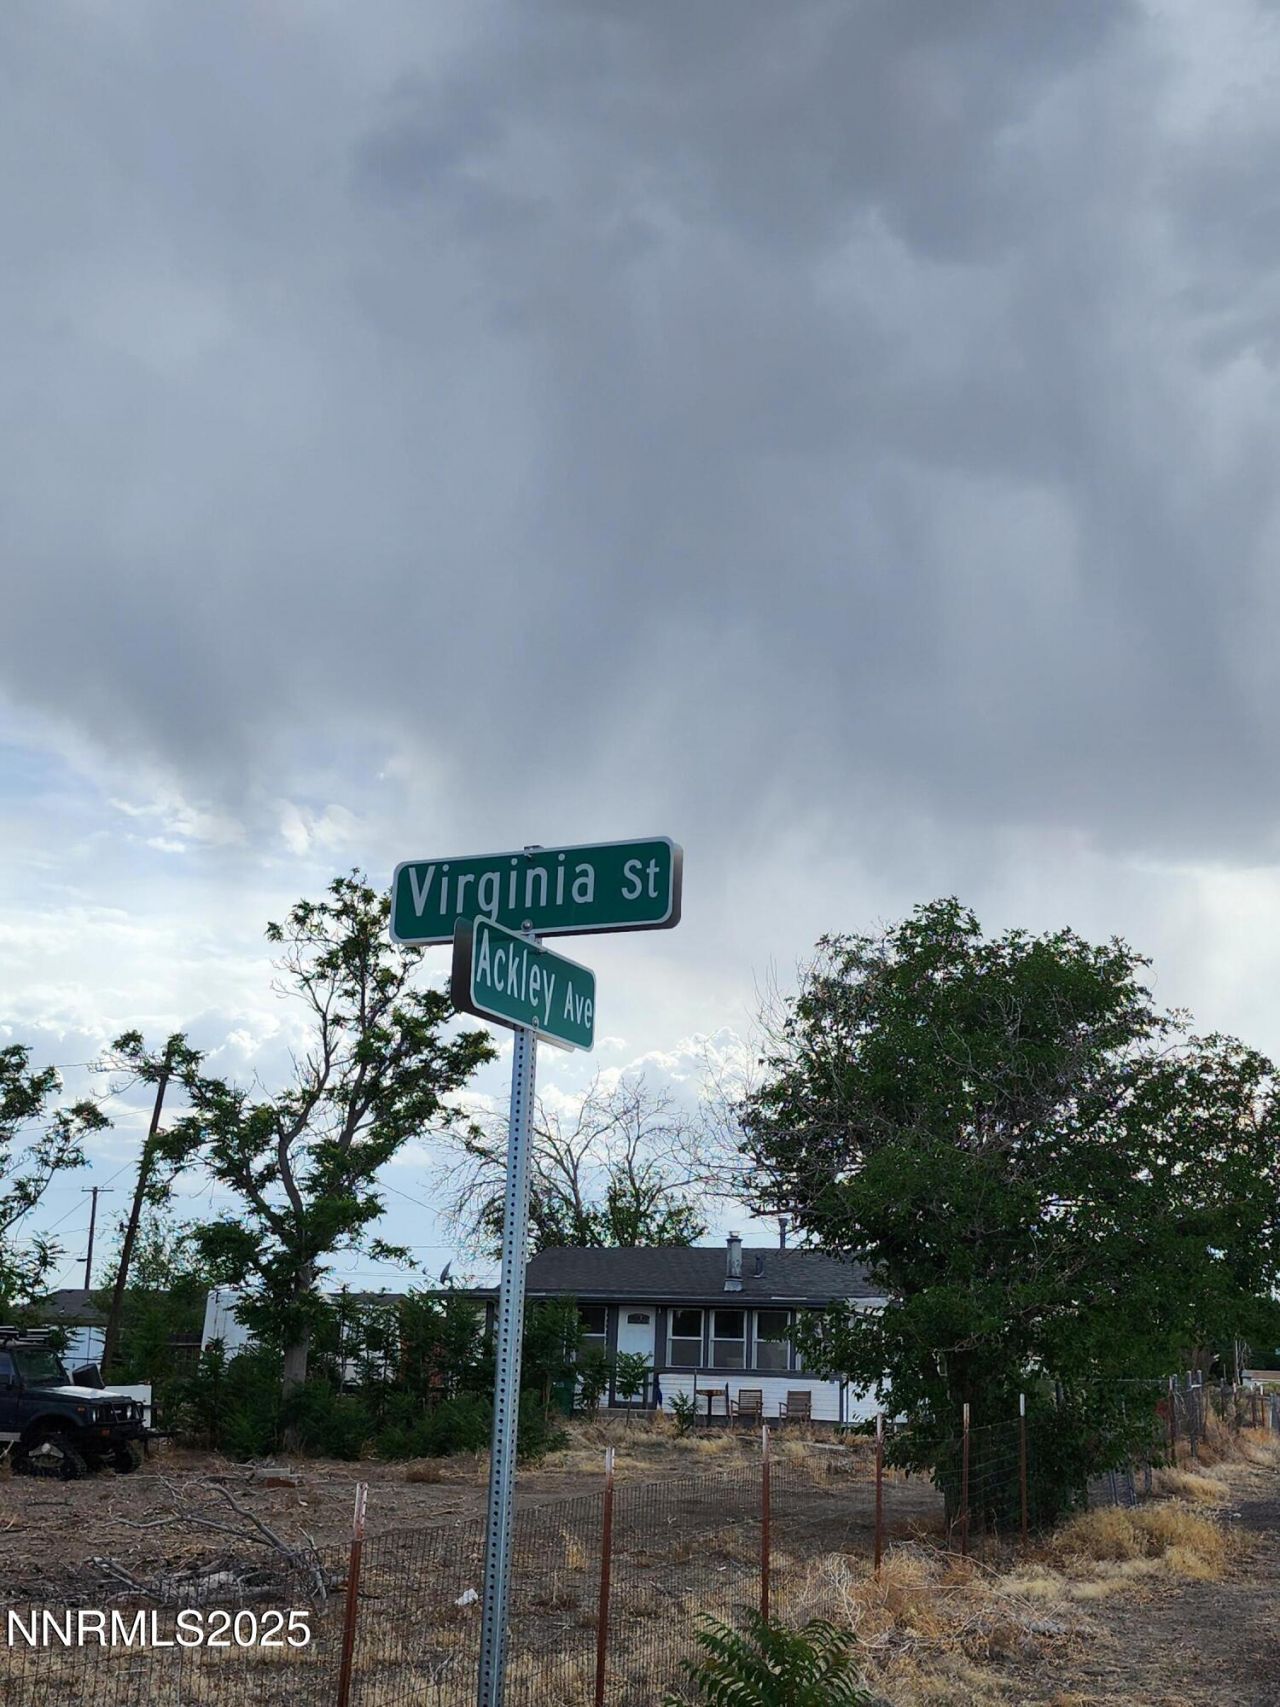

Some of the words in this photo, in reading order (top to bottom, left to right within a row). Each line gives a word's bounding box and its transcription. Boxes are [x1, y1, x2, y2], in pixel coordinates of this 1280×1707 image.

[408, 853, 595, 921] Virginia
[621, 857, 660, 900] St
[476, 928, 556, 1026] Ackley
[563, 981, 593, 1029] Ave
